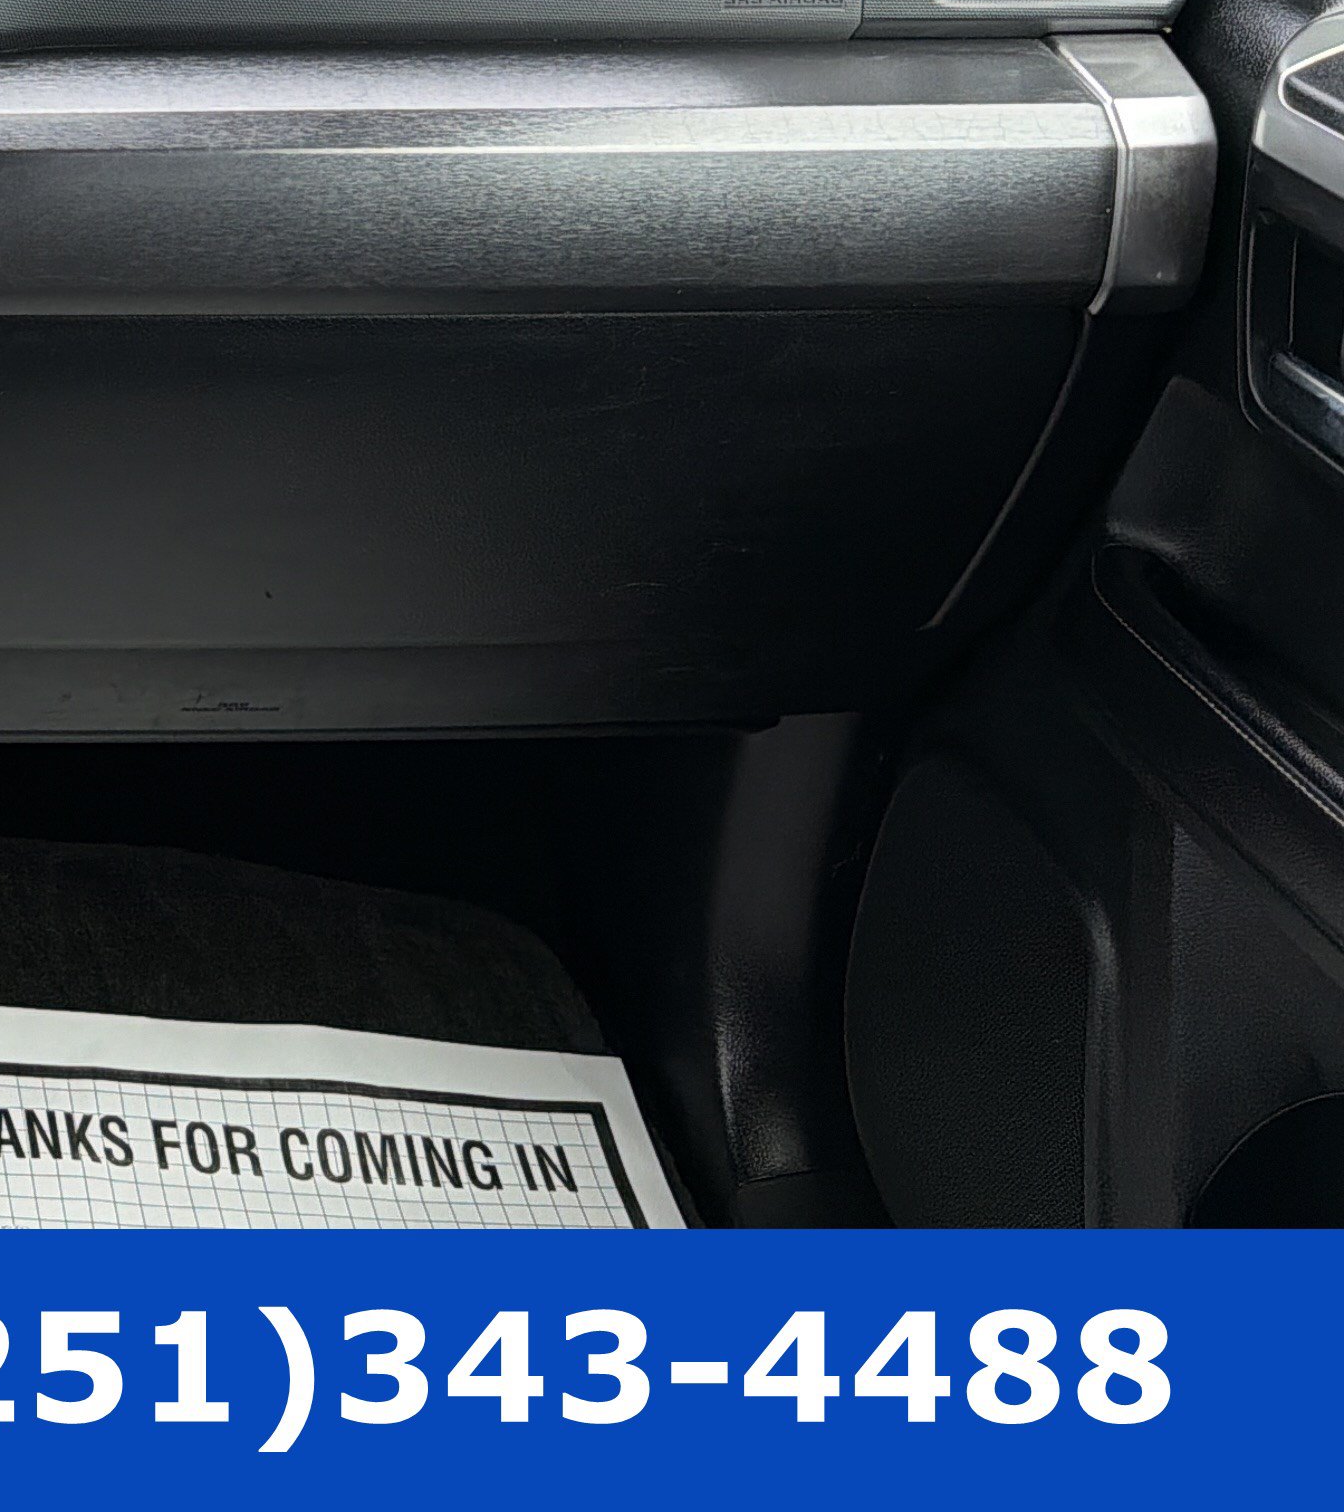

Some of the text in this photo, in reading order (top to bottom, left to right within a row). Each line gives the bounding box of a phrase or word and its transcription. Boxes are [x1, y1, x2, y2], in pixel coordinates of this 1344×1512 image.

[150, 1118, 264, 1178] FOR
[278, 1125, 504, 1192] COMING
[517, 1143, 580, 1194] IN
